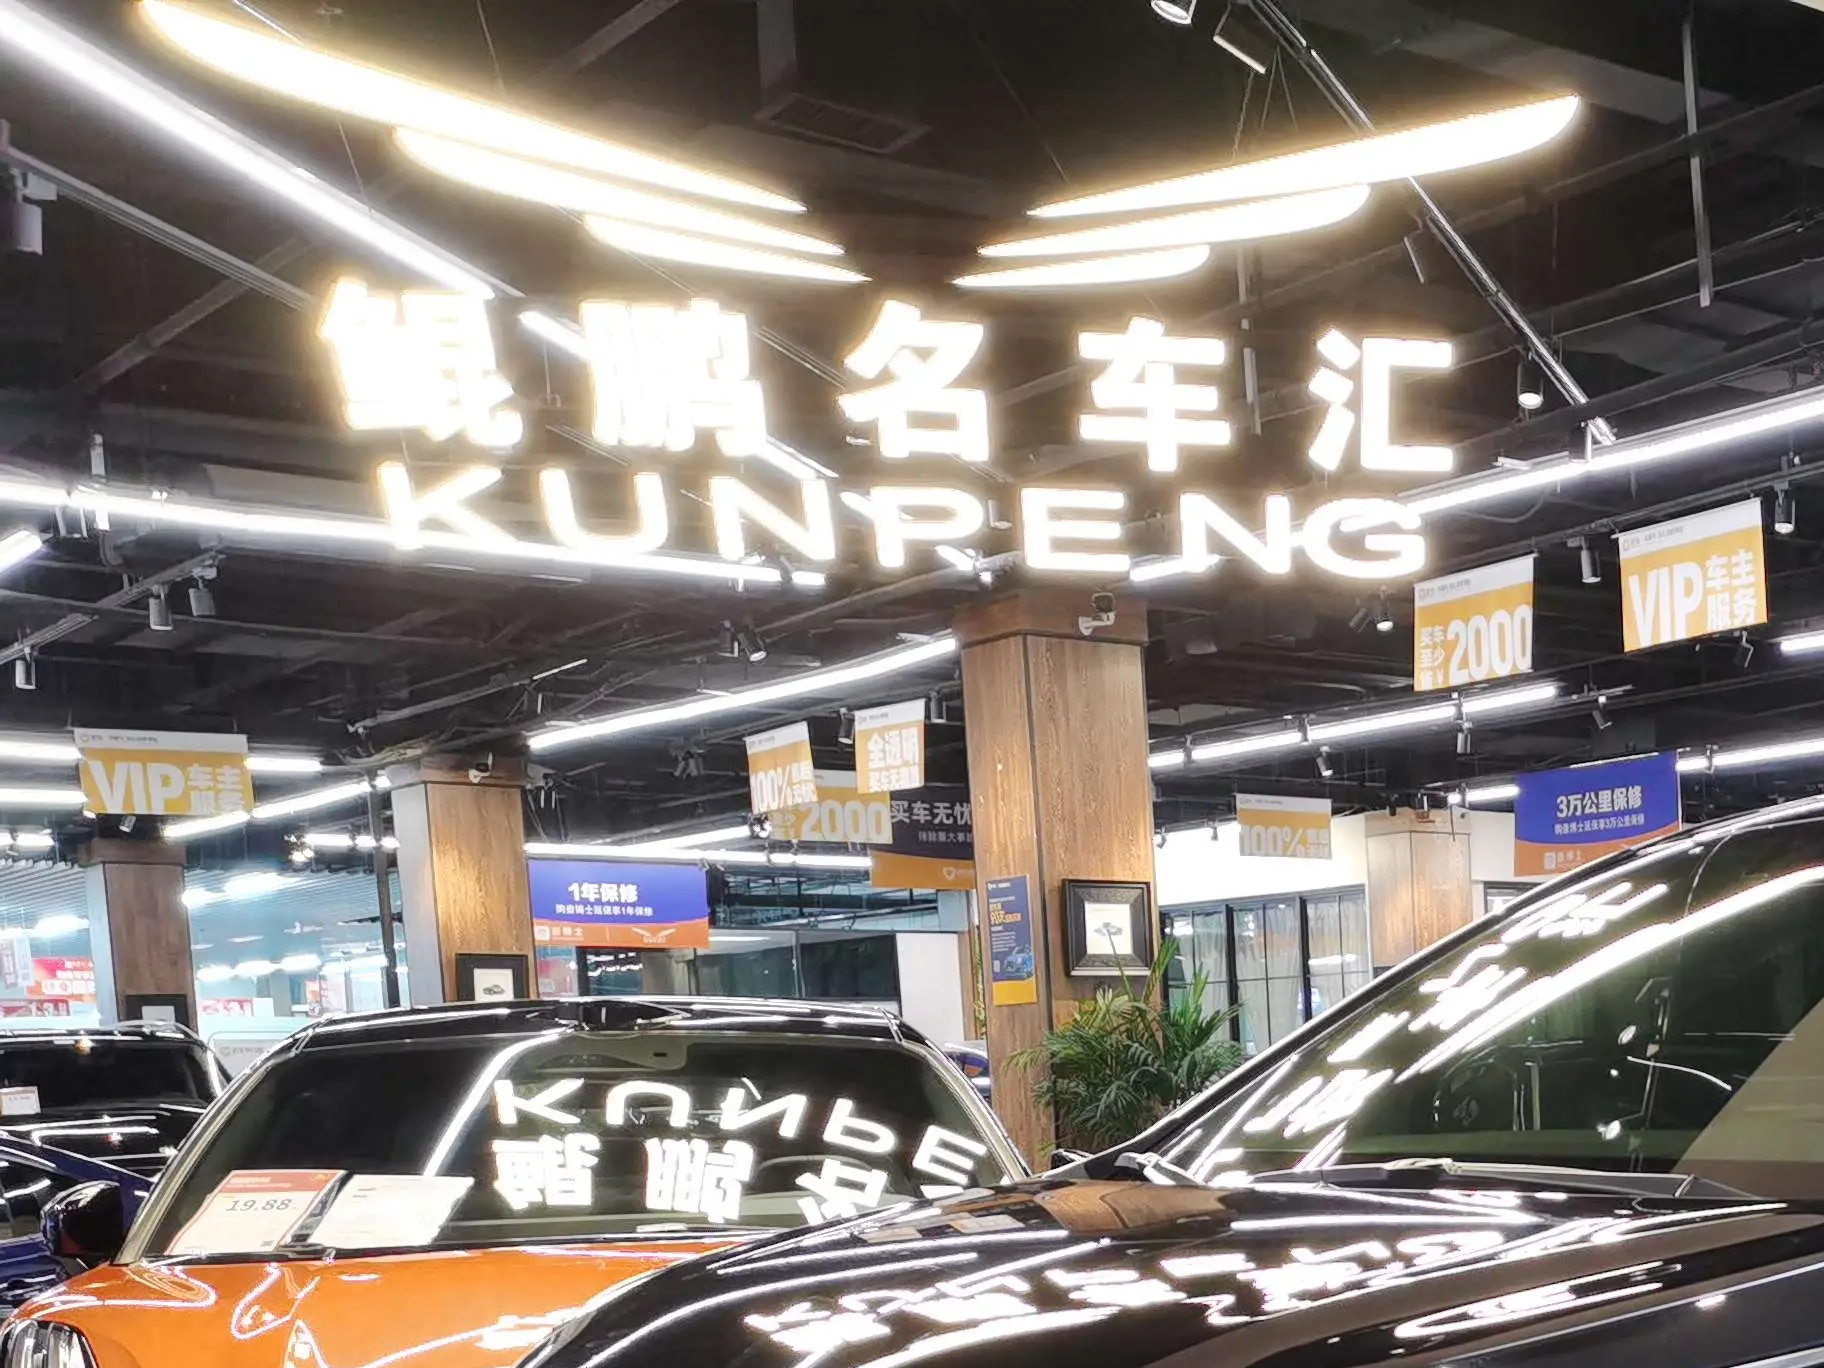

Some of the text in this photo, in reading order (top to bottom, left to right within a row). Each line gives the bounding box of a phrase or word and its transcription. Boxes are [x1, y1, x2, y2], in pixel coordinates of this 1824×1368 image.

[376, 460, 1430, 582] KUNPENG
[1705, 548, 1757, 590] 车主
[1628, 560, 1704, 648] VIP
[1707, 588, 1758, 632] 服务
[1446, 603, 1533, 686] 2000
[88, 760, 186, 815] VIP
[186, 763, 244, 790] 车主
[800, 798, 888, 842] 2000
[1556, 785, 1643, 819] 3万公里保修
[567, 882, 639, 904] 1年保修
[225, 1198, 294, 1213] 19.88
